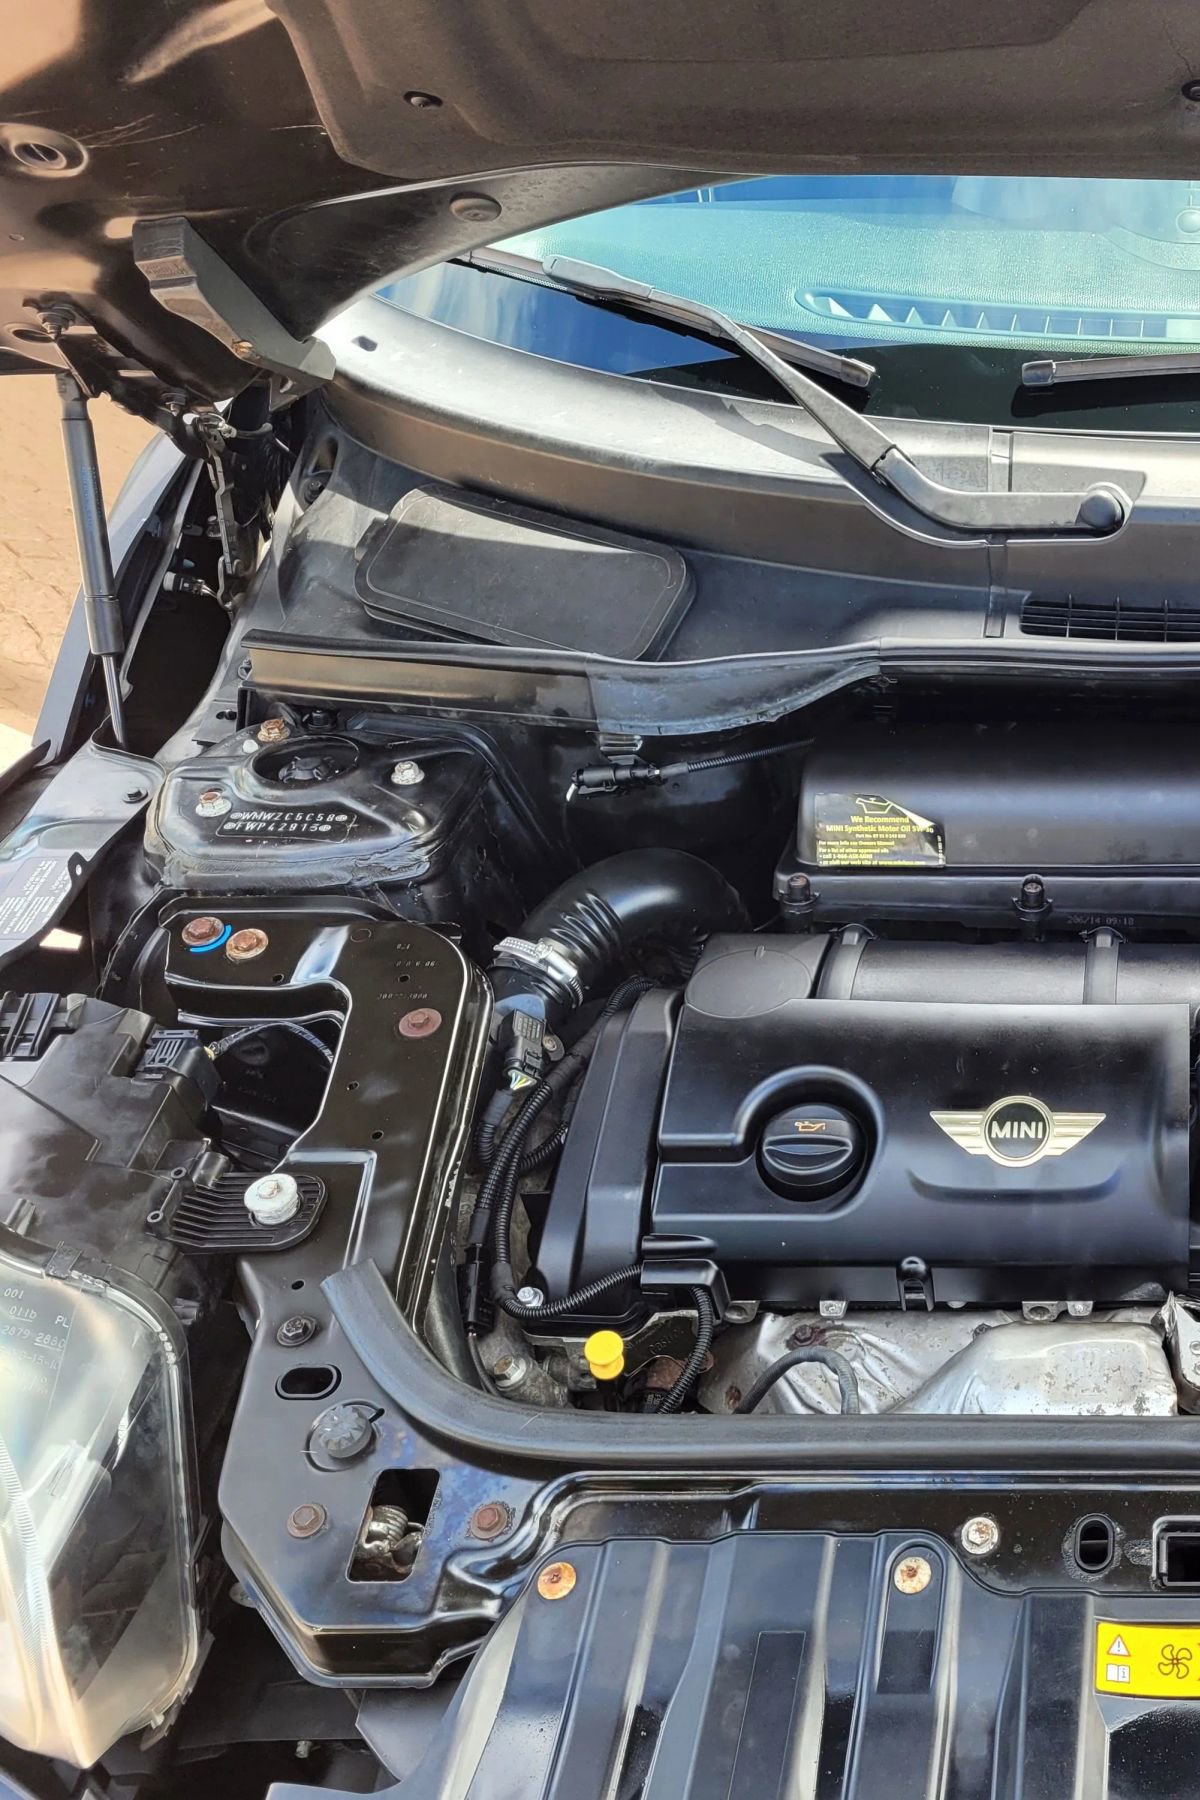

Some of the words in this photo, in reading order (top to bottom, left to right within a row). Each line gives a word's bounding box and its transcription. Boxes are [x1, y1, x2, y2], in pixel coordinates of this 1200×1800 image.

[850, 815, 863, 823] We
[864, 815, 909, 823] Recommend
[844, 824, 876, 834] Synthetic
[991, 1121, 1043, 1139] MINI
[4, 1287, 24, 1299] 001
[1, 1325, 31, 1339] 2879
